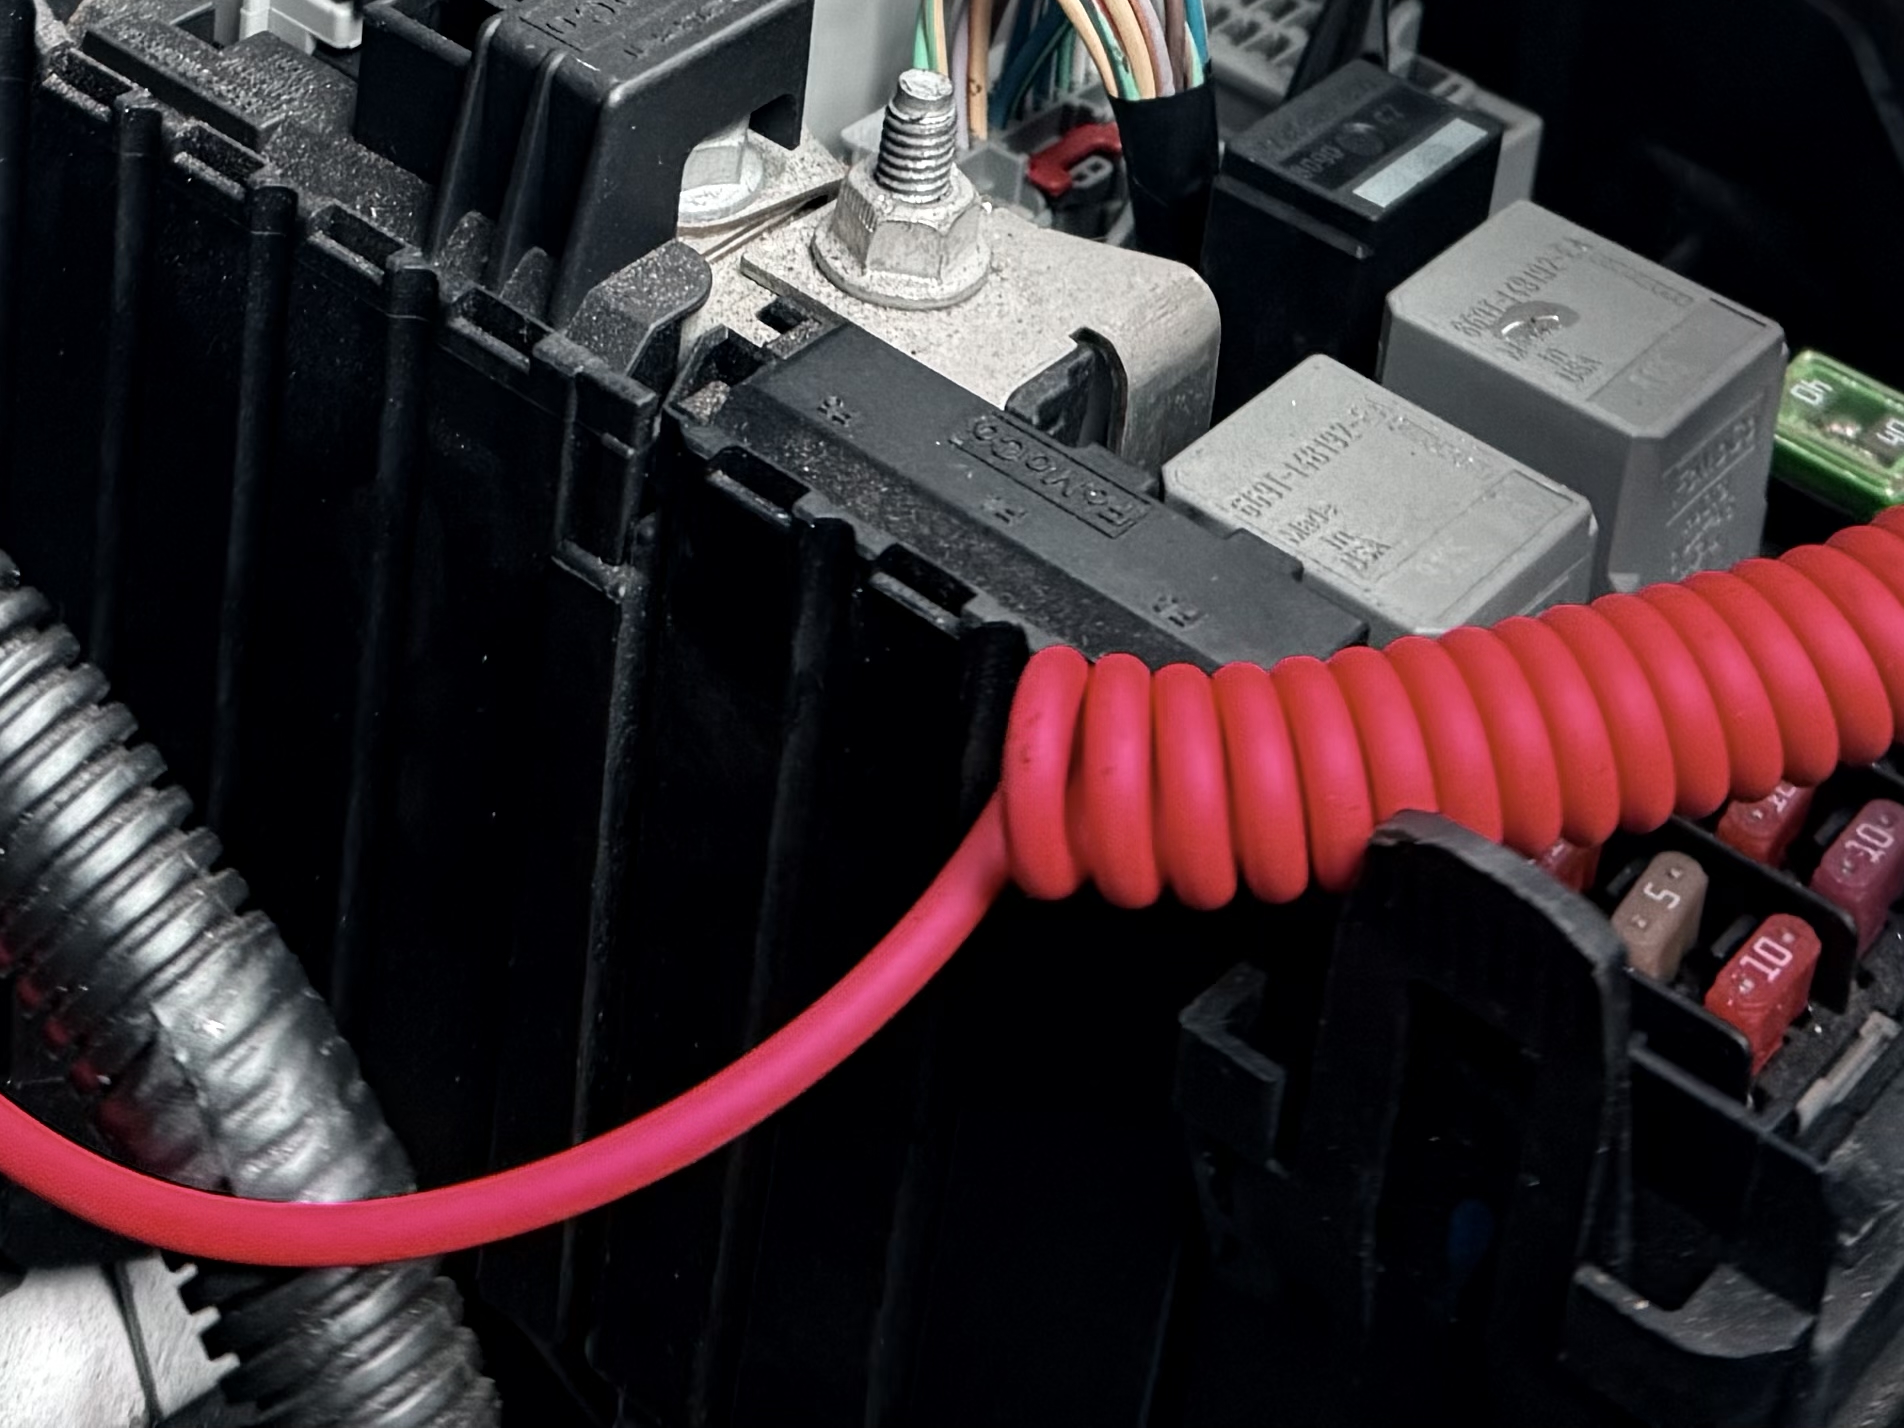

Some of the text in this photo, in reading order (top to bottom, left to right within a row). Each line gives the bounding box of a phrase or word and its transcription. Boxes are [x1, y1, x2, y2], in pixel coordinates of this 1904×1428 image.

[1790, 379, 1834, 406] 40
[1845, 823, 1894, 863] 10
[1643, 882, 1681, 910] 5
[1740, 935, 1794, 982] 10
